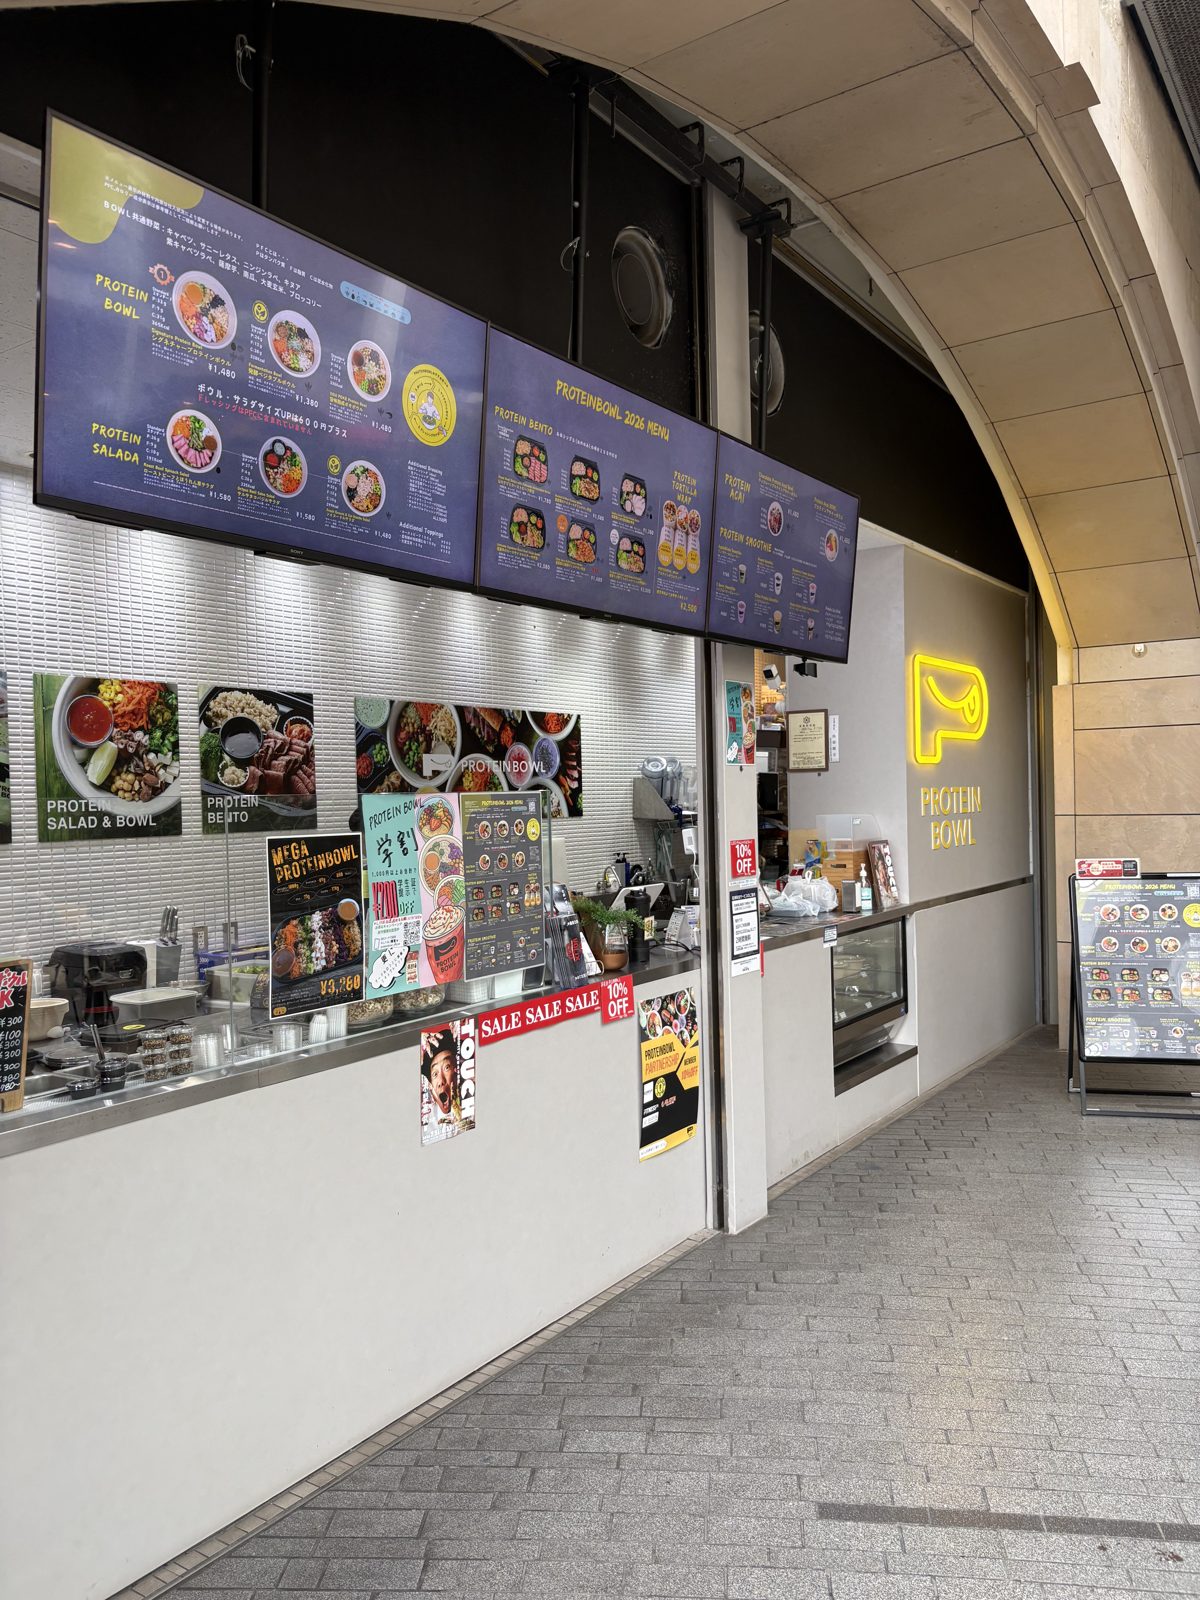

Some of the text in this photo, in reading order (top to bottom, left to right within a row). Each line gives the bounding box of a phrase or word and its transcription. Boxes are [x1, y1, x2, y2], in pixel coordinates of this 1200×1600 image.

[95, 273, 149, 304] PROTEIN
[104, 297, 142, 321] BOWL
[151, 335, 232, 367] シグネチャープロテインボウル
[207, 363, 236, 381] ¥1,480
[295, 394, 319, 408] ¥1,380
[556, 378, 671, 443] PROTEINBOWL 2026 MENU
[494, 405, 527, 426] PROTEIN
[529, 418, 554, 438] BENTO
[91, 424, 142, 448] PROTEIN
[92, 446, 140, 467] SALADA
[673, 470, 698, 487] PROTEIN
[725, 473, 751, 493] PROTEIN
[209, 490, 232, 504] ¥1,580
[729, 488, 746, 503] ACAI
[399, 521, 424, 535] Additional
[720, 527, 773, 554] PROTEIN SMOOTHIE
[290, 548, 304, 557] SONY
[47, 799, 111, 813] PROTEIN
[207, 795, 259, 809] PROTEIN
[921, 786, 983, 817] PROTEIN
[47, 813, 157, 829] SALAD & BOWL
[369, 798, 425, 831] PROTEIN BOWL
[930, 819, 977, 851] BOWL
[270, 839, 311, 867] MEGA
[376, 827, 419, 868] 学割
[735, 843, 752, 859] 10%
[274, 843, 360, 884] PROTEINBOWL
[736, 858, 753, 874] OFF
[399, 900, 416, 915] OFF
[436, 950, 459, 968] PROTEIN
[440, 960, 457, 973] BOWL
[607, 981, 628, 1000] 10%
[480, 988, 599, 1039] SALE SALE SALE
[608, 997, 629, 1018] OFF
[645, 1041, 676, 1061] PROTEINBOWL
[0, 1063, 21, 1072] 300
[459, 1017, 476, 1121] TOUCH
[645, 1053, 680, 1076] PARTNERSHIP
